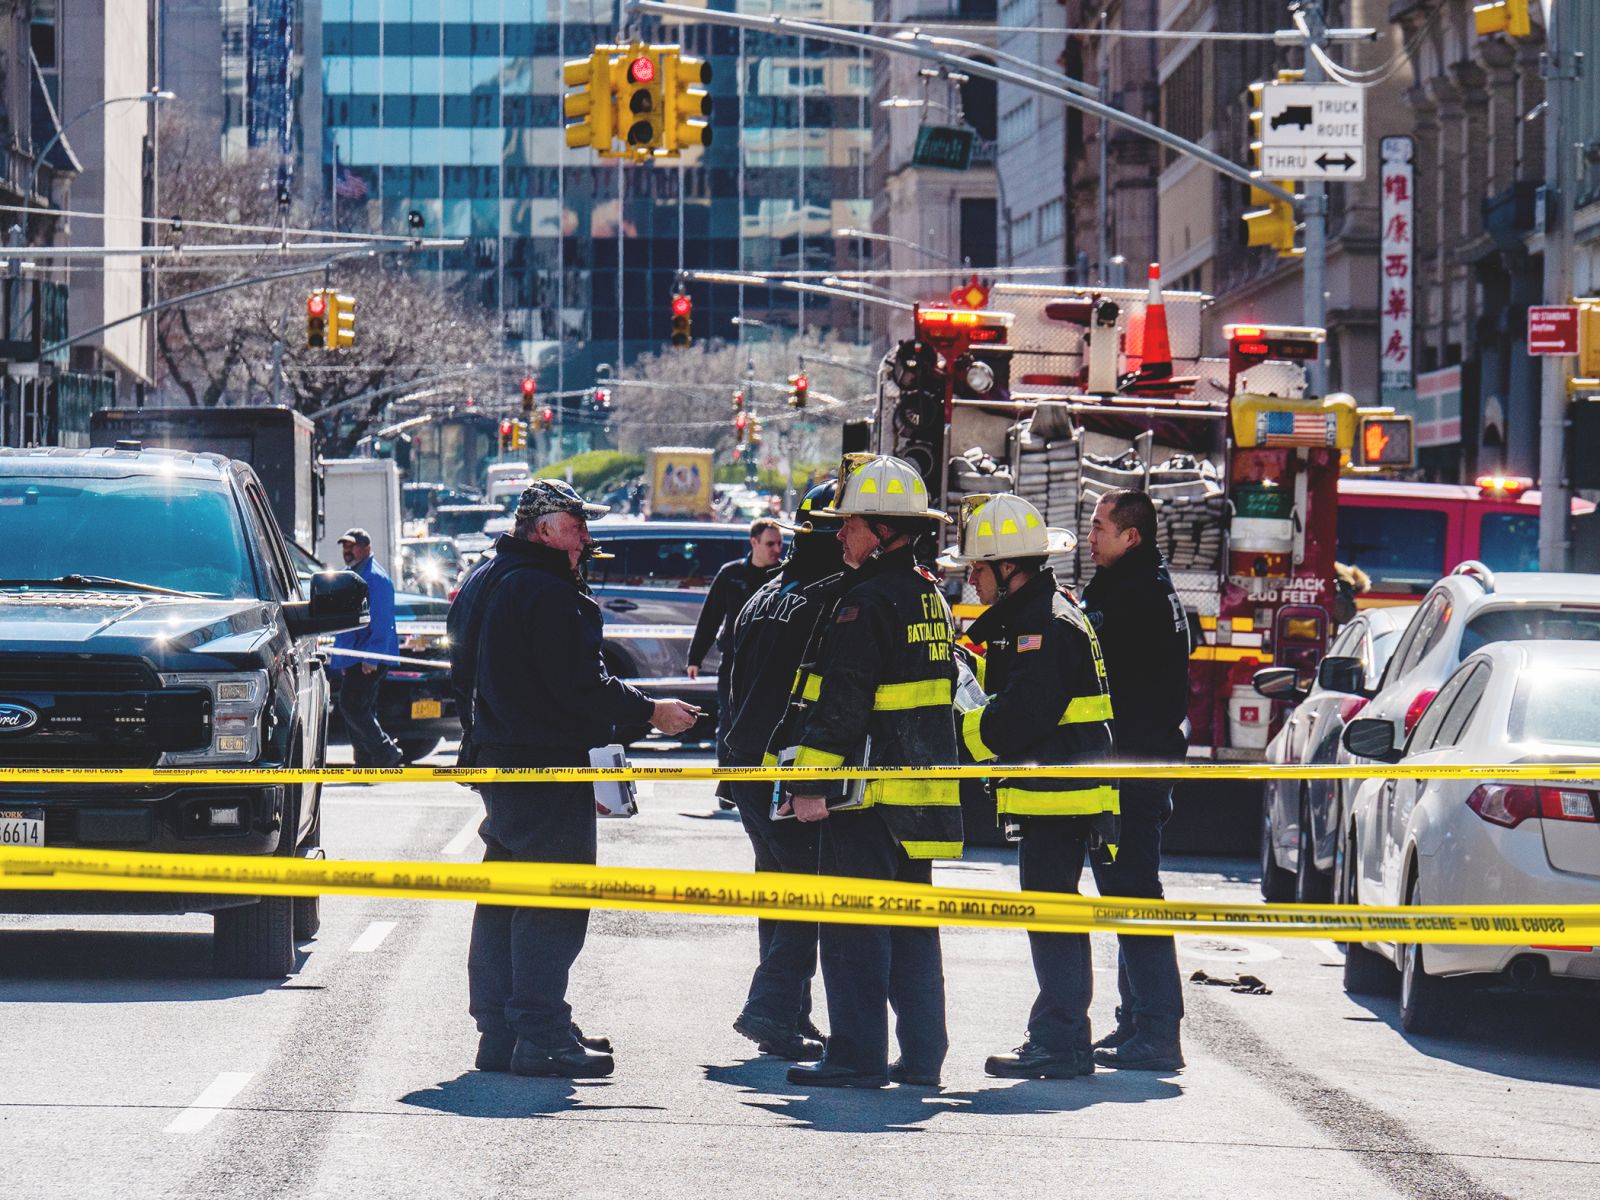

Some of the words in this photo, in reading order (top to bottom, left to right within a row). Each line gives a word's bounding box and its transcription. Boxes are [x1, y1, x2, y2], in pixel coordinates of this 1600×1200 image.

[1317, 100, 1359, 113] TRUCK
[1317, 124, 1359, 137] ROUTE
[1267, 156, 1307, 168] THRU
[1247, 590, 1278, 602] 200
[1281, 590, 1318, 603] FEET
[907, 622, 947, 644] BATTALION
[0, 811, 24, 820] YORK
[0, 821, 39, 844] 6614
